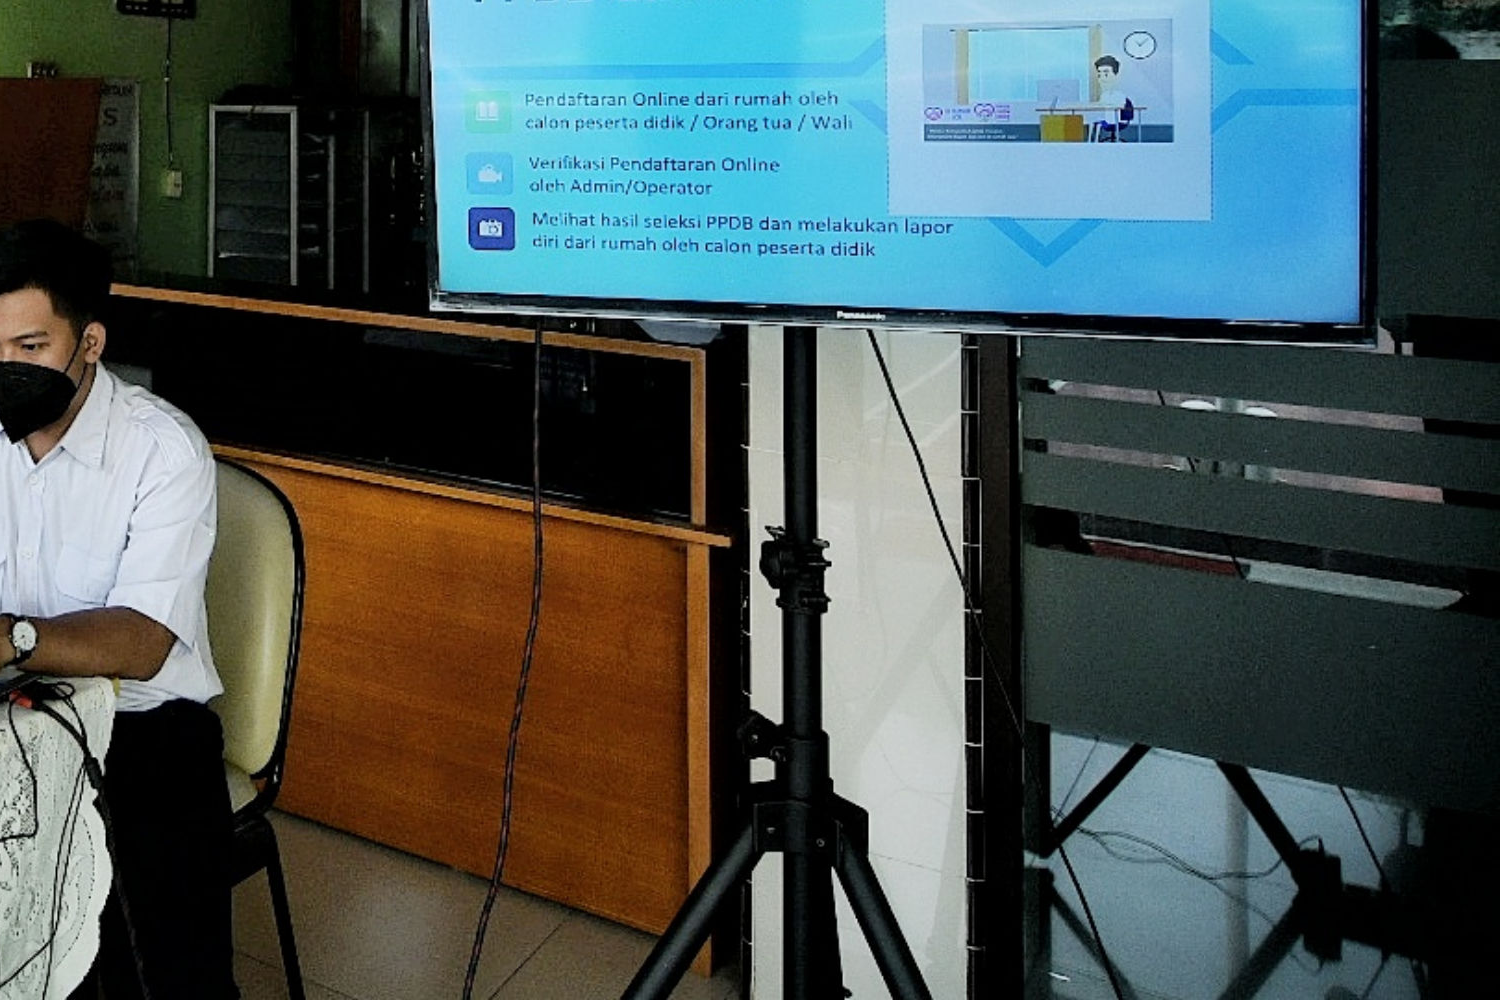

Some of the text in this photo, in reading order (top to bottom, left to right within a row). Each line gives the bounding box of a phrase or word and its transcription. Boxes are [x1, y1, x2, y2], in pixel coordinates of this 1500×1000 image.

[525, 91, 839, 107] Pendaftaran Online dari rumah oleh
[525, 116, 853, 133] calon peserta didik / Orang tua / Wali
[528, 157, 781, 172] Verifikasi Pendaftaran Online
[529, 179, 712, 196] oleh Admin/Operator
[532, 212, 954, 237] Melihat hasil seleksi PPDB dan melakukan lapor
[532, 235, 876, 257] diri dari rumah oleh calon peserta didik
